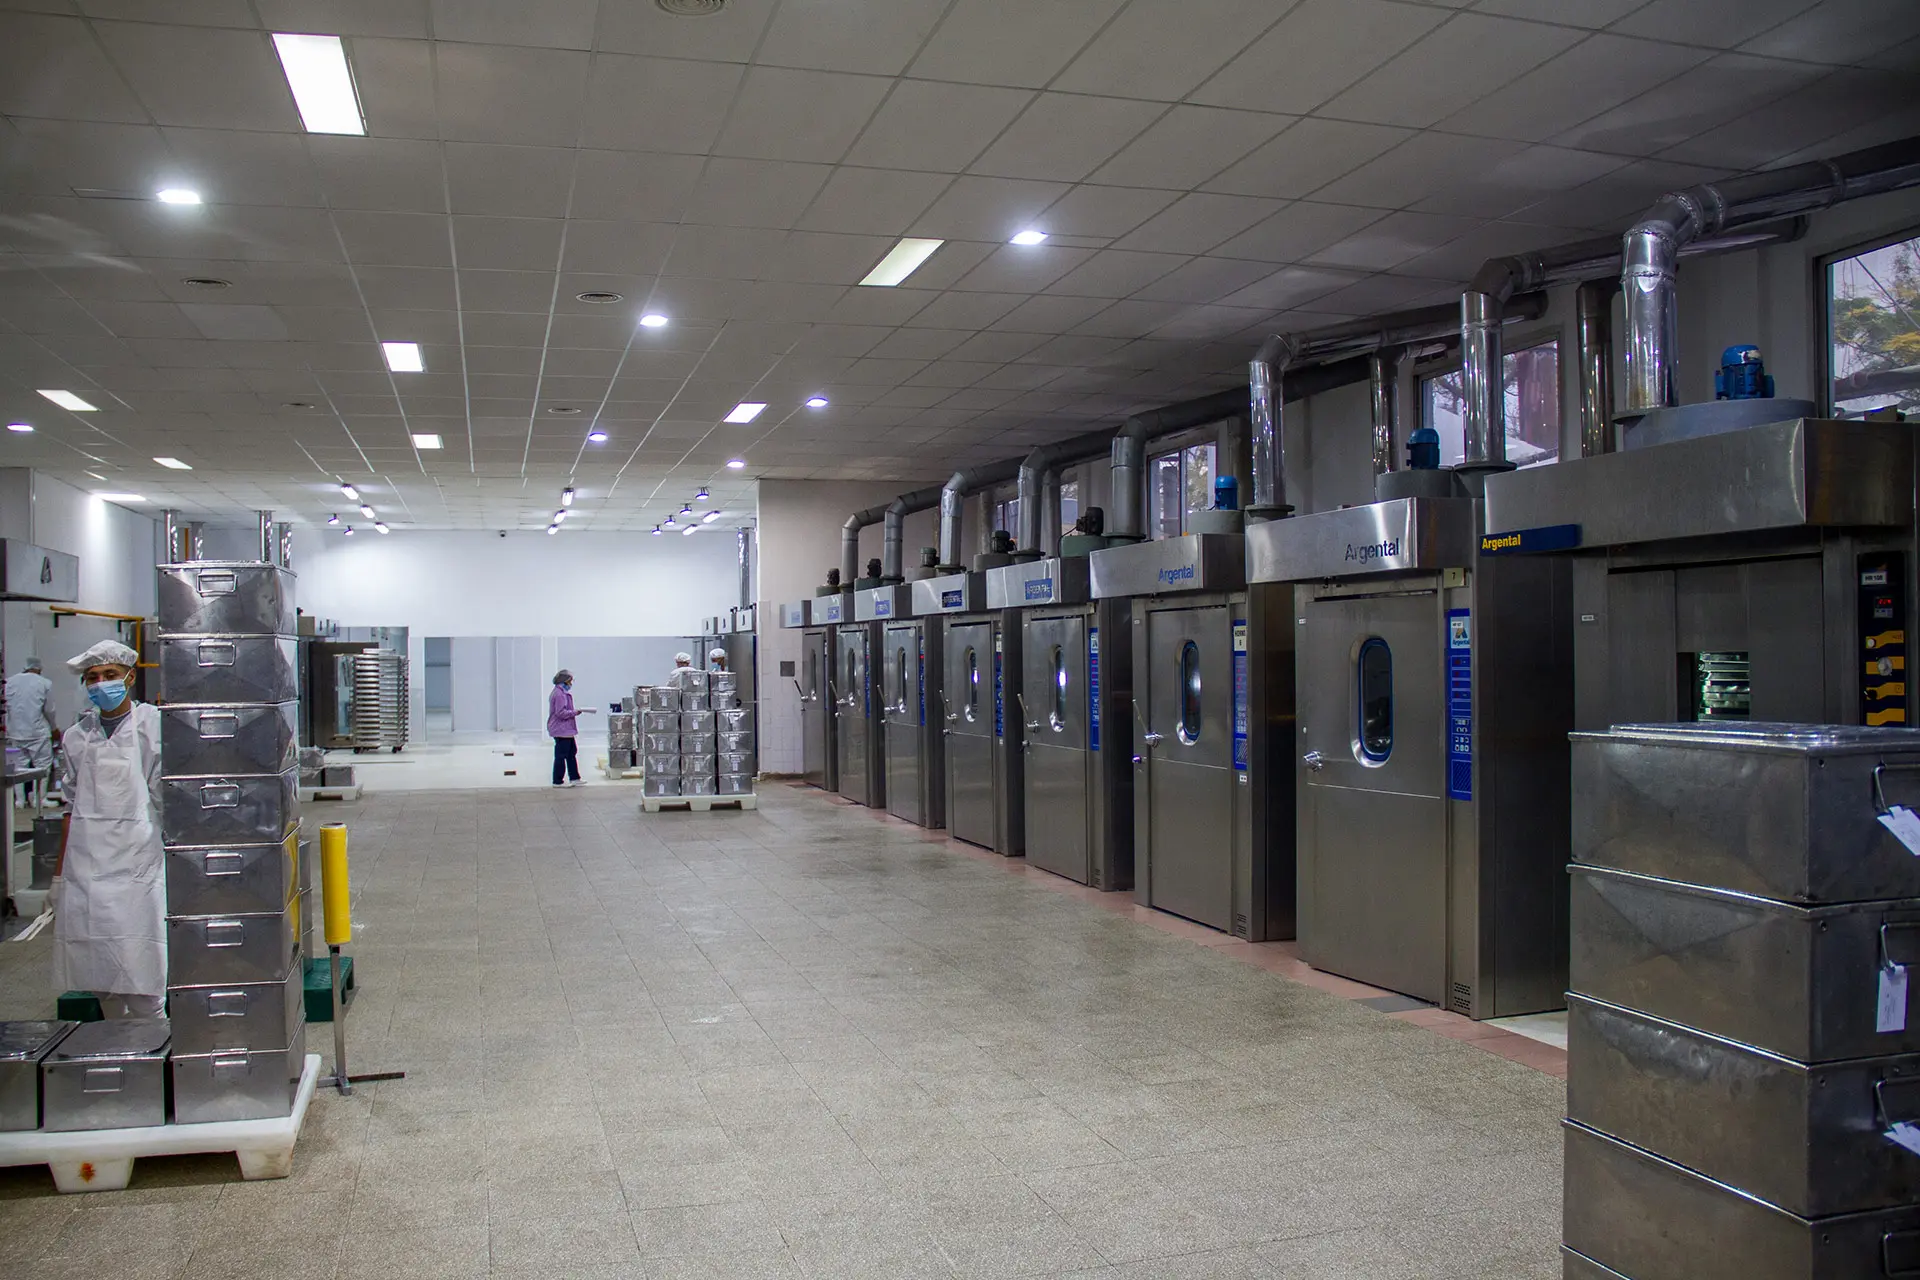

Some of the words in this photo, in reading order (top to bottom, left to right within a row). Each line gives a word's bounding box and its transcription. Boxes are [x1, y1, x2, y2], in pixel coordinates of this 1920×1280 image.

[1345, 537, 1399, 564] Argental
[1482, 534, 1521, 550] Argental
[1158, 563, 1194, 584] Argental
